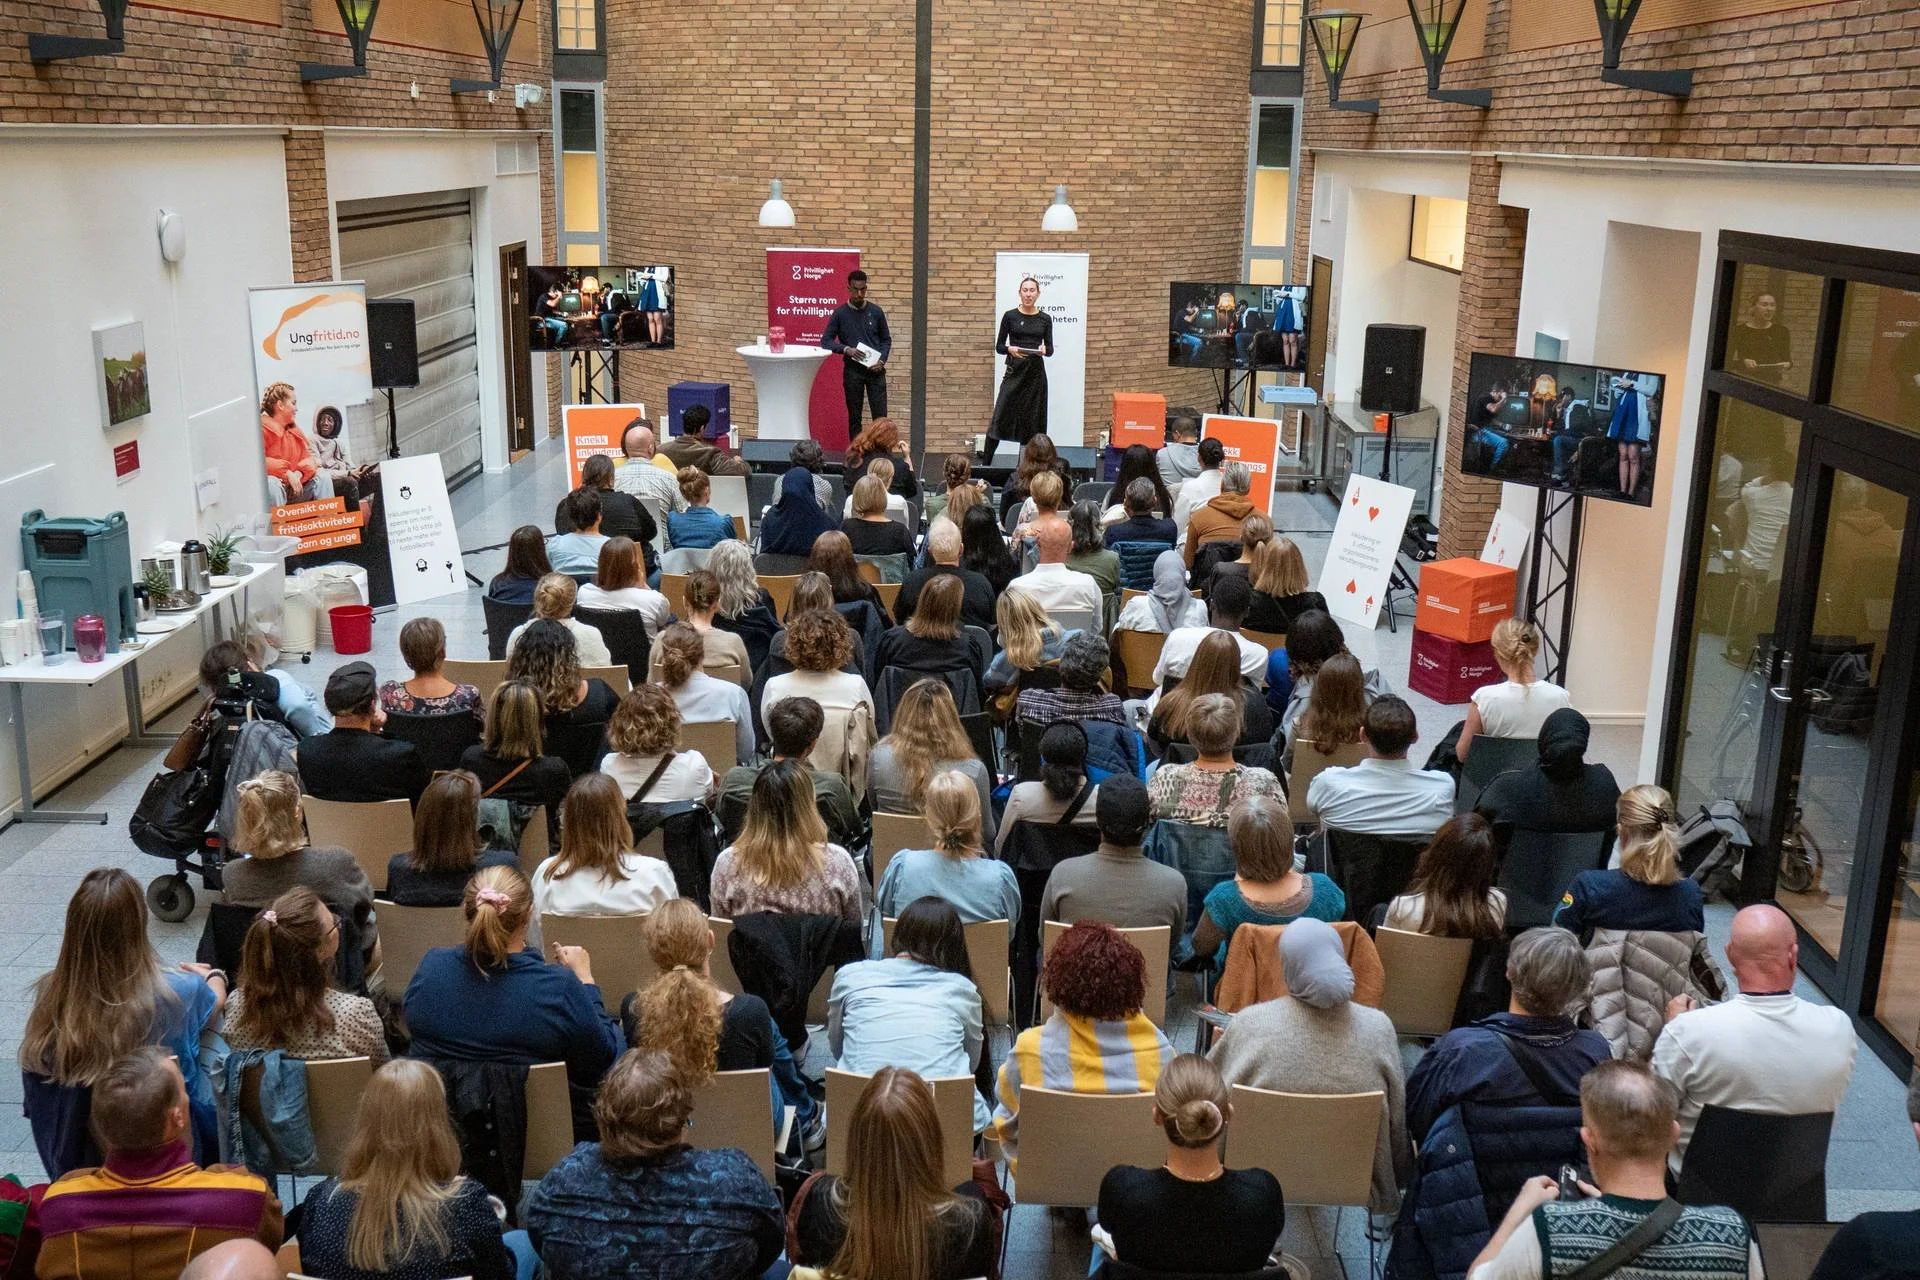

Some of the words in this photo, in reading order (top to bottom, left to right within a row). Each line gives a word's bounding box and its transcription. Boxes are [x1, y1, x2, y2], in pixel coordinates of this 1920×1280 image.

[789, 296, 817, 304] Større
[776, 307, 790, 315] for
[792, 307, 834, 317] frivillighe
[290, 329, 360, 346] Ungfritid.no
[577, 435, 606, 444] Knekk
[578, 448, 625, 457] inkluderin
[1223, 447, 1238, 456] ekk
[277, 505, 316, 517] Oversikt
[319, 501, 338, 510] over
[279, 515, 356, 535] fritidsaktiviteter
[320, 537, 332, 547] og
[334, 533, 357, 544] unge
